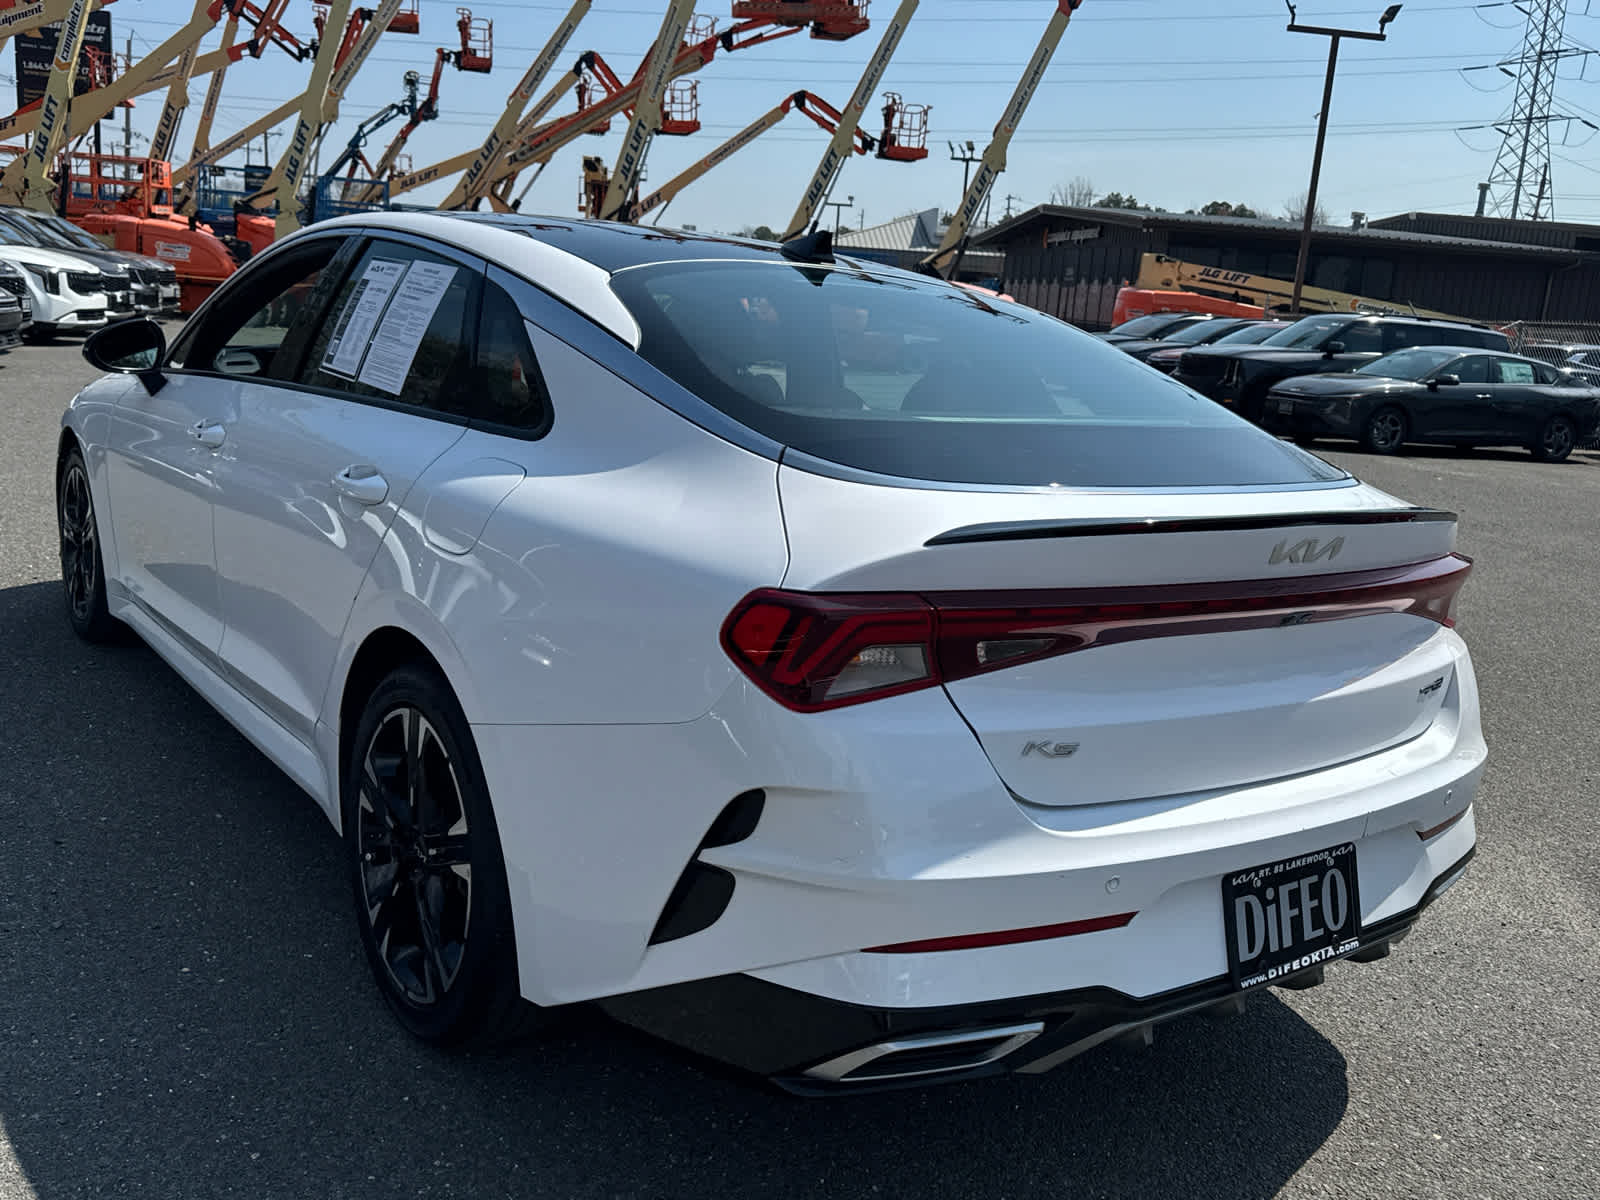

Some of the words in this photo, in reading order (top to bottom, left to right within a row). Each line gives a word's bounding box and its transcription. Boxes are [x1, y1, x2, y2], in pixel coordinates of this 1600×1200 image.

[0, 4, 43, 26] uipment
[61, 2, 82, 61] complete
[41, 94, 58, 131] LIFT
[34, 132, 49, 163] JLG
[285, 155, 300, 185] JLG
[293, 119, 310, 155] LIFT
[465, 159, 483, 184] JLG
[480, 131, 501, 161] LIFT
[620, 153, 634, 180] JLG
[630, 119, 647, 153] LIFT
[418, 168, 439, 182] LIFT
[807, 179, 823, 208] JLG
[820, 147, 838, 182] LIFT
[963, 194, 977, 221] JLG
[975, 163, 992, 197] LIFT
[1198, 267, 1222, 279] JLG
[1223, 270, 1251, 284] LIFT
[1022, 740, 1080, 758] K5
[1258, 867, 1272, 878] RT.
[1286, 851, 1329, 870] LAKEWOOD
[1235, 868, 1348, 963] DiFEO
